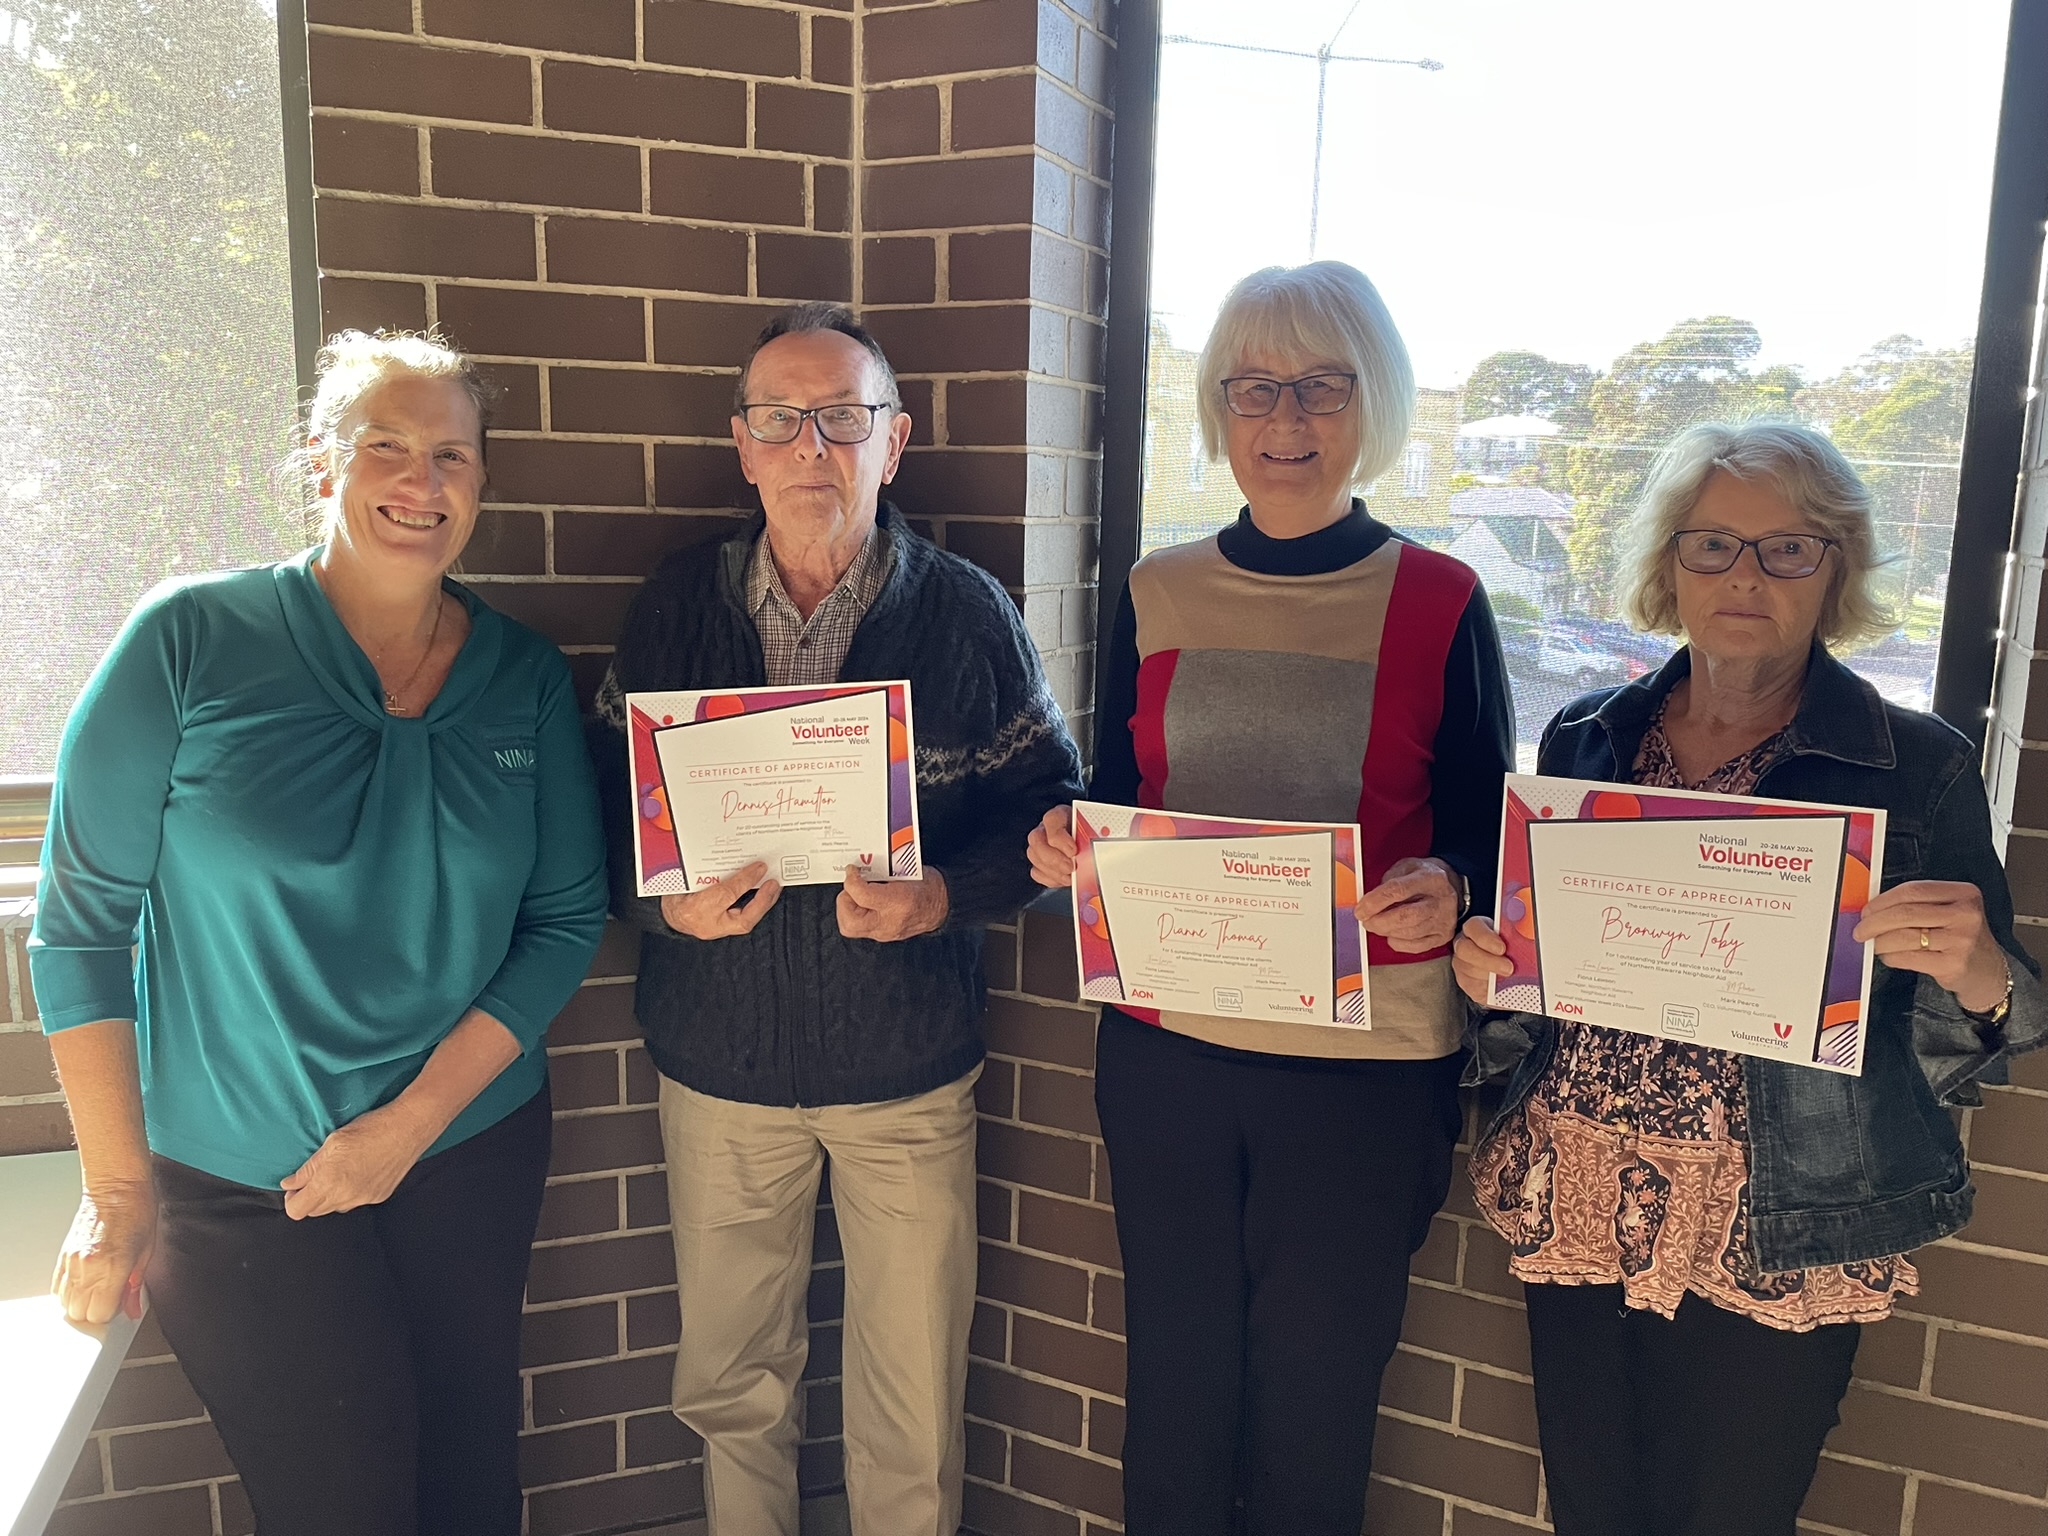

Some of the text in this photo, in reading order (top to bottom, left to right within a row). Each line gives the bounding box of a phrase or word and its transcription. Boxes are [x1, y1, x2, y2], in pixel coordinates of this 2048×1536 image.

[790, 716, 824, 724] National
[791, 724, 869, 739] Volunteer
[690, 766, 760, 778] CERTIFICATE
[784, 760, 860, 771] APPRECIATION
[721, 790, 770, 822] Dennis
[1700, 833, 1747, 846] National
[1222, 850, 1259, 859] National
[1699, 844, 1813, 872] Volunteer
[1222, 858, 1311, 878] Volunteer
[1698, 864, 1731, 872] Something
[696, 876, 720, 885] AON
[1286, 878, 1312, 887] Week
[1779, 871, 1812, 883] Week
[1123, 886, 1299, 909] CERTIFICATE OF APPRECIATION
[1563, 876, 1791, 910] CERTIFICATE OF APPRECIATION
[1157, 913, 1268, 950] Dianne Thomas
[1601, 906, 1744, 968] Bronwyn Toby
[1620, 955, 1656, 964] outstanding
[1131, 988, 1153, 999] AON
[1268, 1004, 1314, 1014] Volunteering
[1554, 1001, 1583, 1015] AON
[1737, 999, 1759, 1007] Pearce
[1666, 1016, 1693, 1028] NINA
[1731, 1030, 1788, 1048] Volunteering
